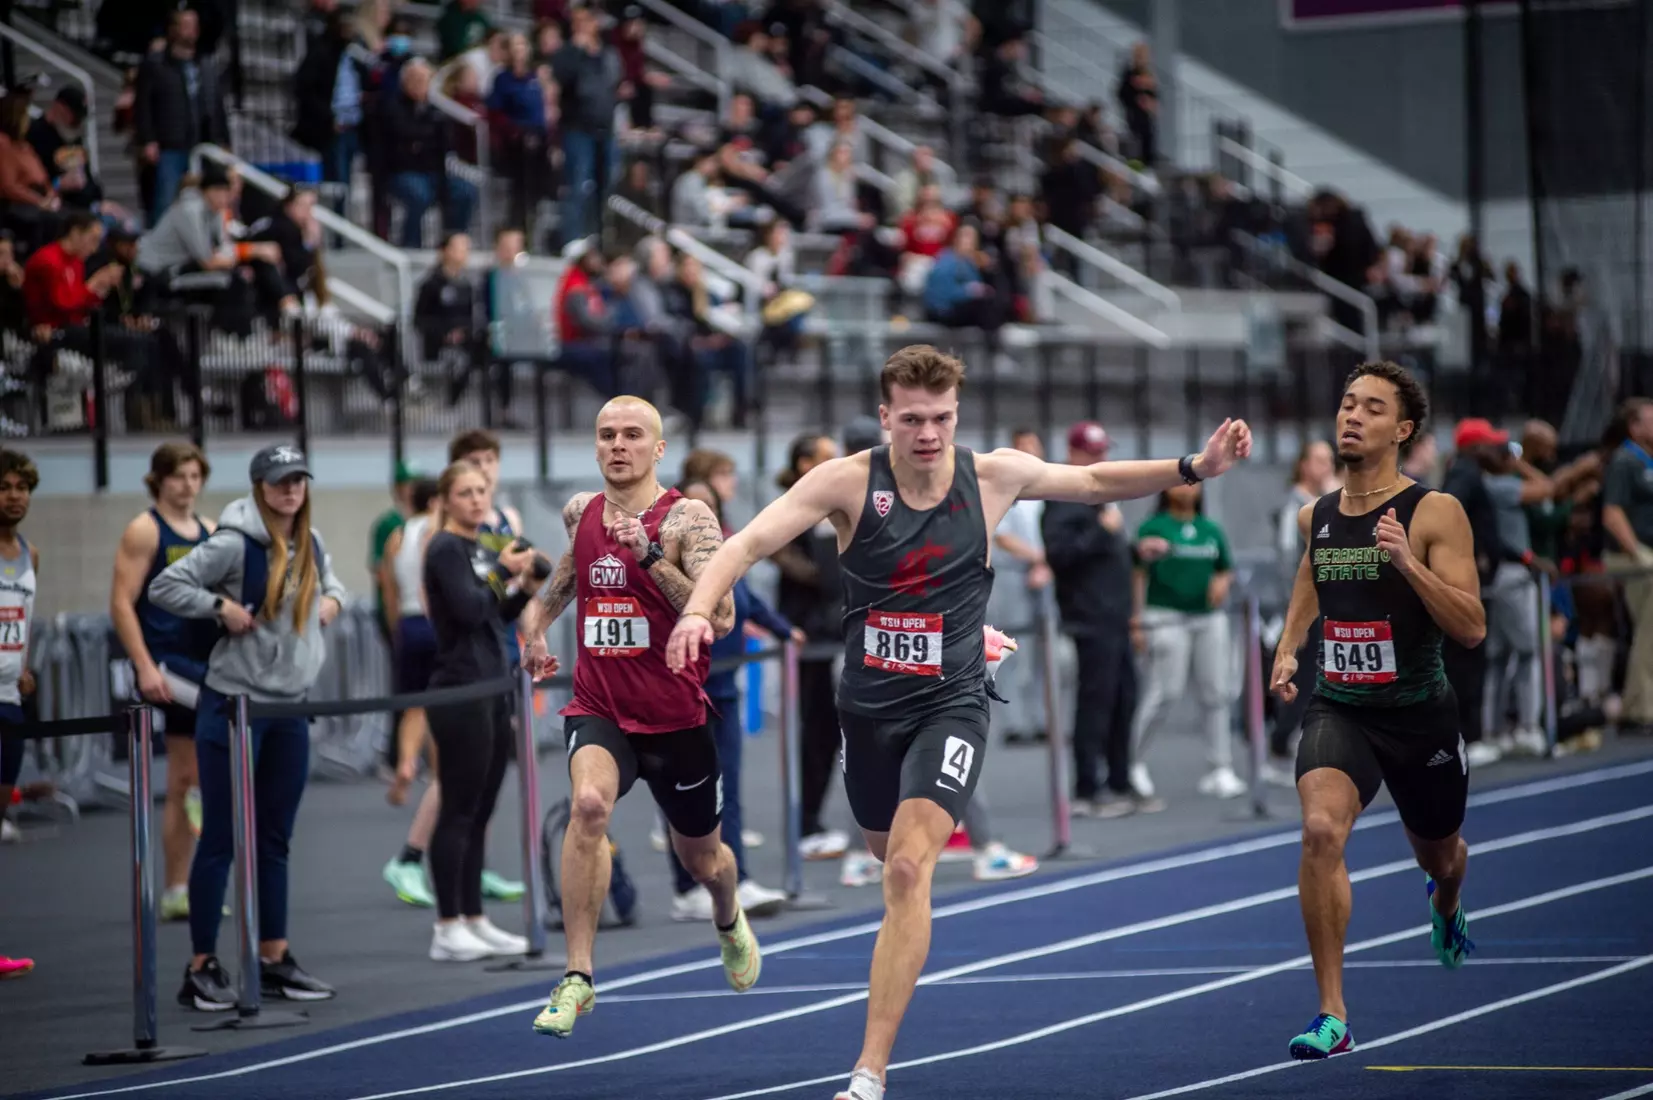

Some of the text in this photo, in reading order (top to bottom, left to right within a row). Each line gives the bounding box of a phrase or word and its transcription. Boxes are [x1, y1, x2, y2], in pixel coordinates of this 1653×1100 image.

[1313, 547, 1392, 566] SACRAMENTO
[1317, 564, 1380, 582] STATE
[597, 602, 633, 613] WSU OPEN
[594, 618, 636, 646] 191
[880, 616, 926, 629] WSU OPEN
[1333, 627, 1376, 638] WSU OPEN
[876, 630, 929, 663] 869
[1333, 642, 1383, 672] 649
[948, 743, 968, 779] 4
